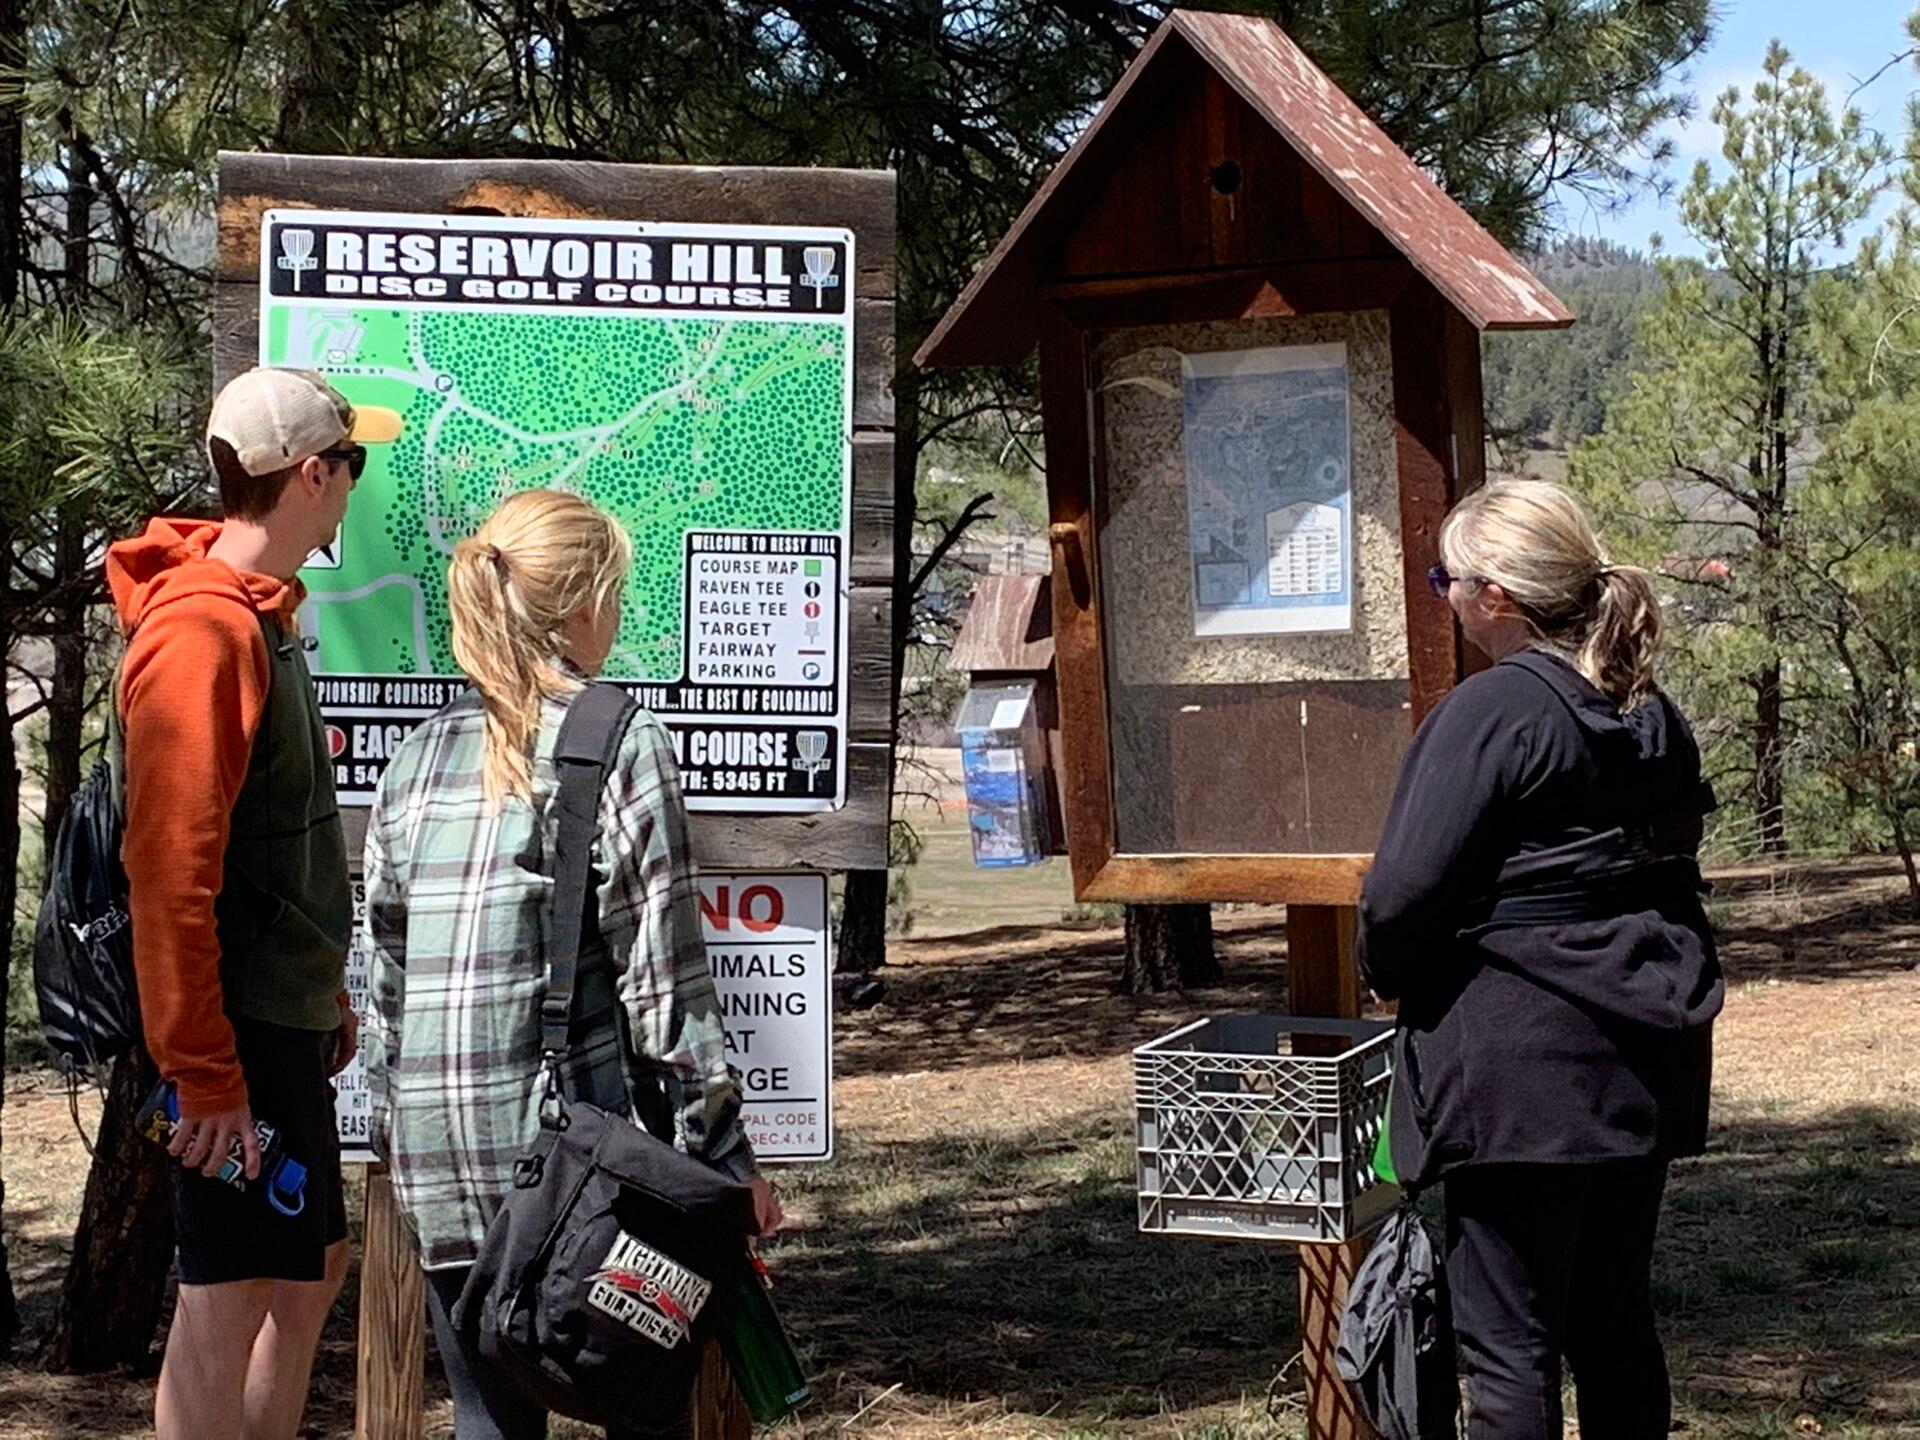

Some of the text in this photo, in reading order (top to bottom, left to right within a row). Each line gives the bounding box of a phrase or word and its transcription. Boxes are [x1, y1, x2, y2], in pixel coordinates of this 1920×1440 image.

[326, 232, 791, 284] RESERVOIR HILL
[325, 274, 791, 307] DISC GOLF COURSE
[692, 535, 748, 552] WELCOME
[752, 536, 767, 552] TO
[810, 538, 836, 554] HILL
[700, 560, 799, 575] COURSE MAP
[700, 581, 750, 595] RAVEN
[756, 582, 784, 596] TEE
[700, 601, 751, 615] EAGLE
[759, 602, 788, 616] TEE
[700, 622, 771, 636] TARGET
[698, 642, 776, 657] FAIRWAY
[698, 663, 776, 679] PARKING
[313, 682, 381, 704] PIONSHIP
[385, 683, 444, 705] COURSES
[707, 689, 739, 711] BEST
[742, 690, 758, 711] OF
[762, 690, 833, 713] COLORADO!
[353, 725, 412, 759] EAG
[690, 730, 788, 766] COURSE
[713, 771, 761, 791] 5345
[766, 772, 788, 791] FT
[700, 885, 784, 933] NO
[712, 954, 805, 978] IMALS
[720, 992, 806, 1017] NING
[724, 1030, 755, 1053] AT
[341, 1115, 373, 1136] EAS
[775, 1112, 817, 1126] CODE
[600, 1229, 712, 1323] LIGHTNING
